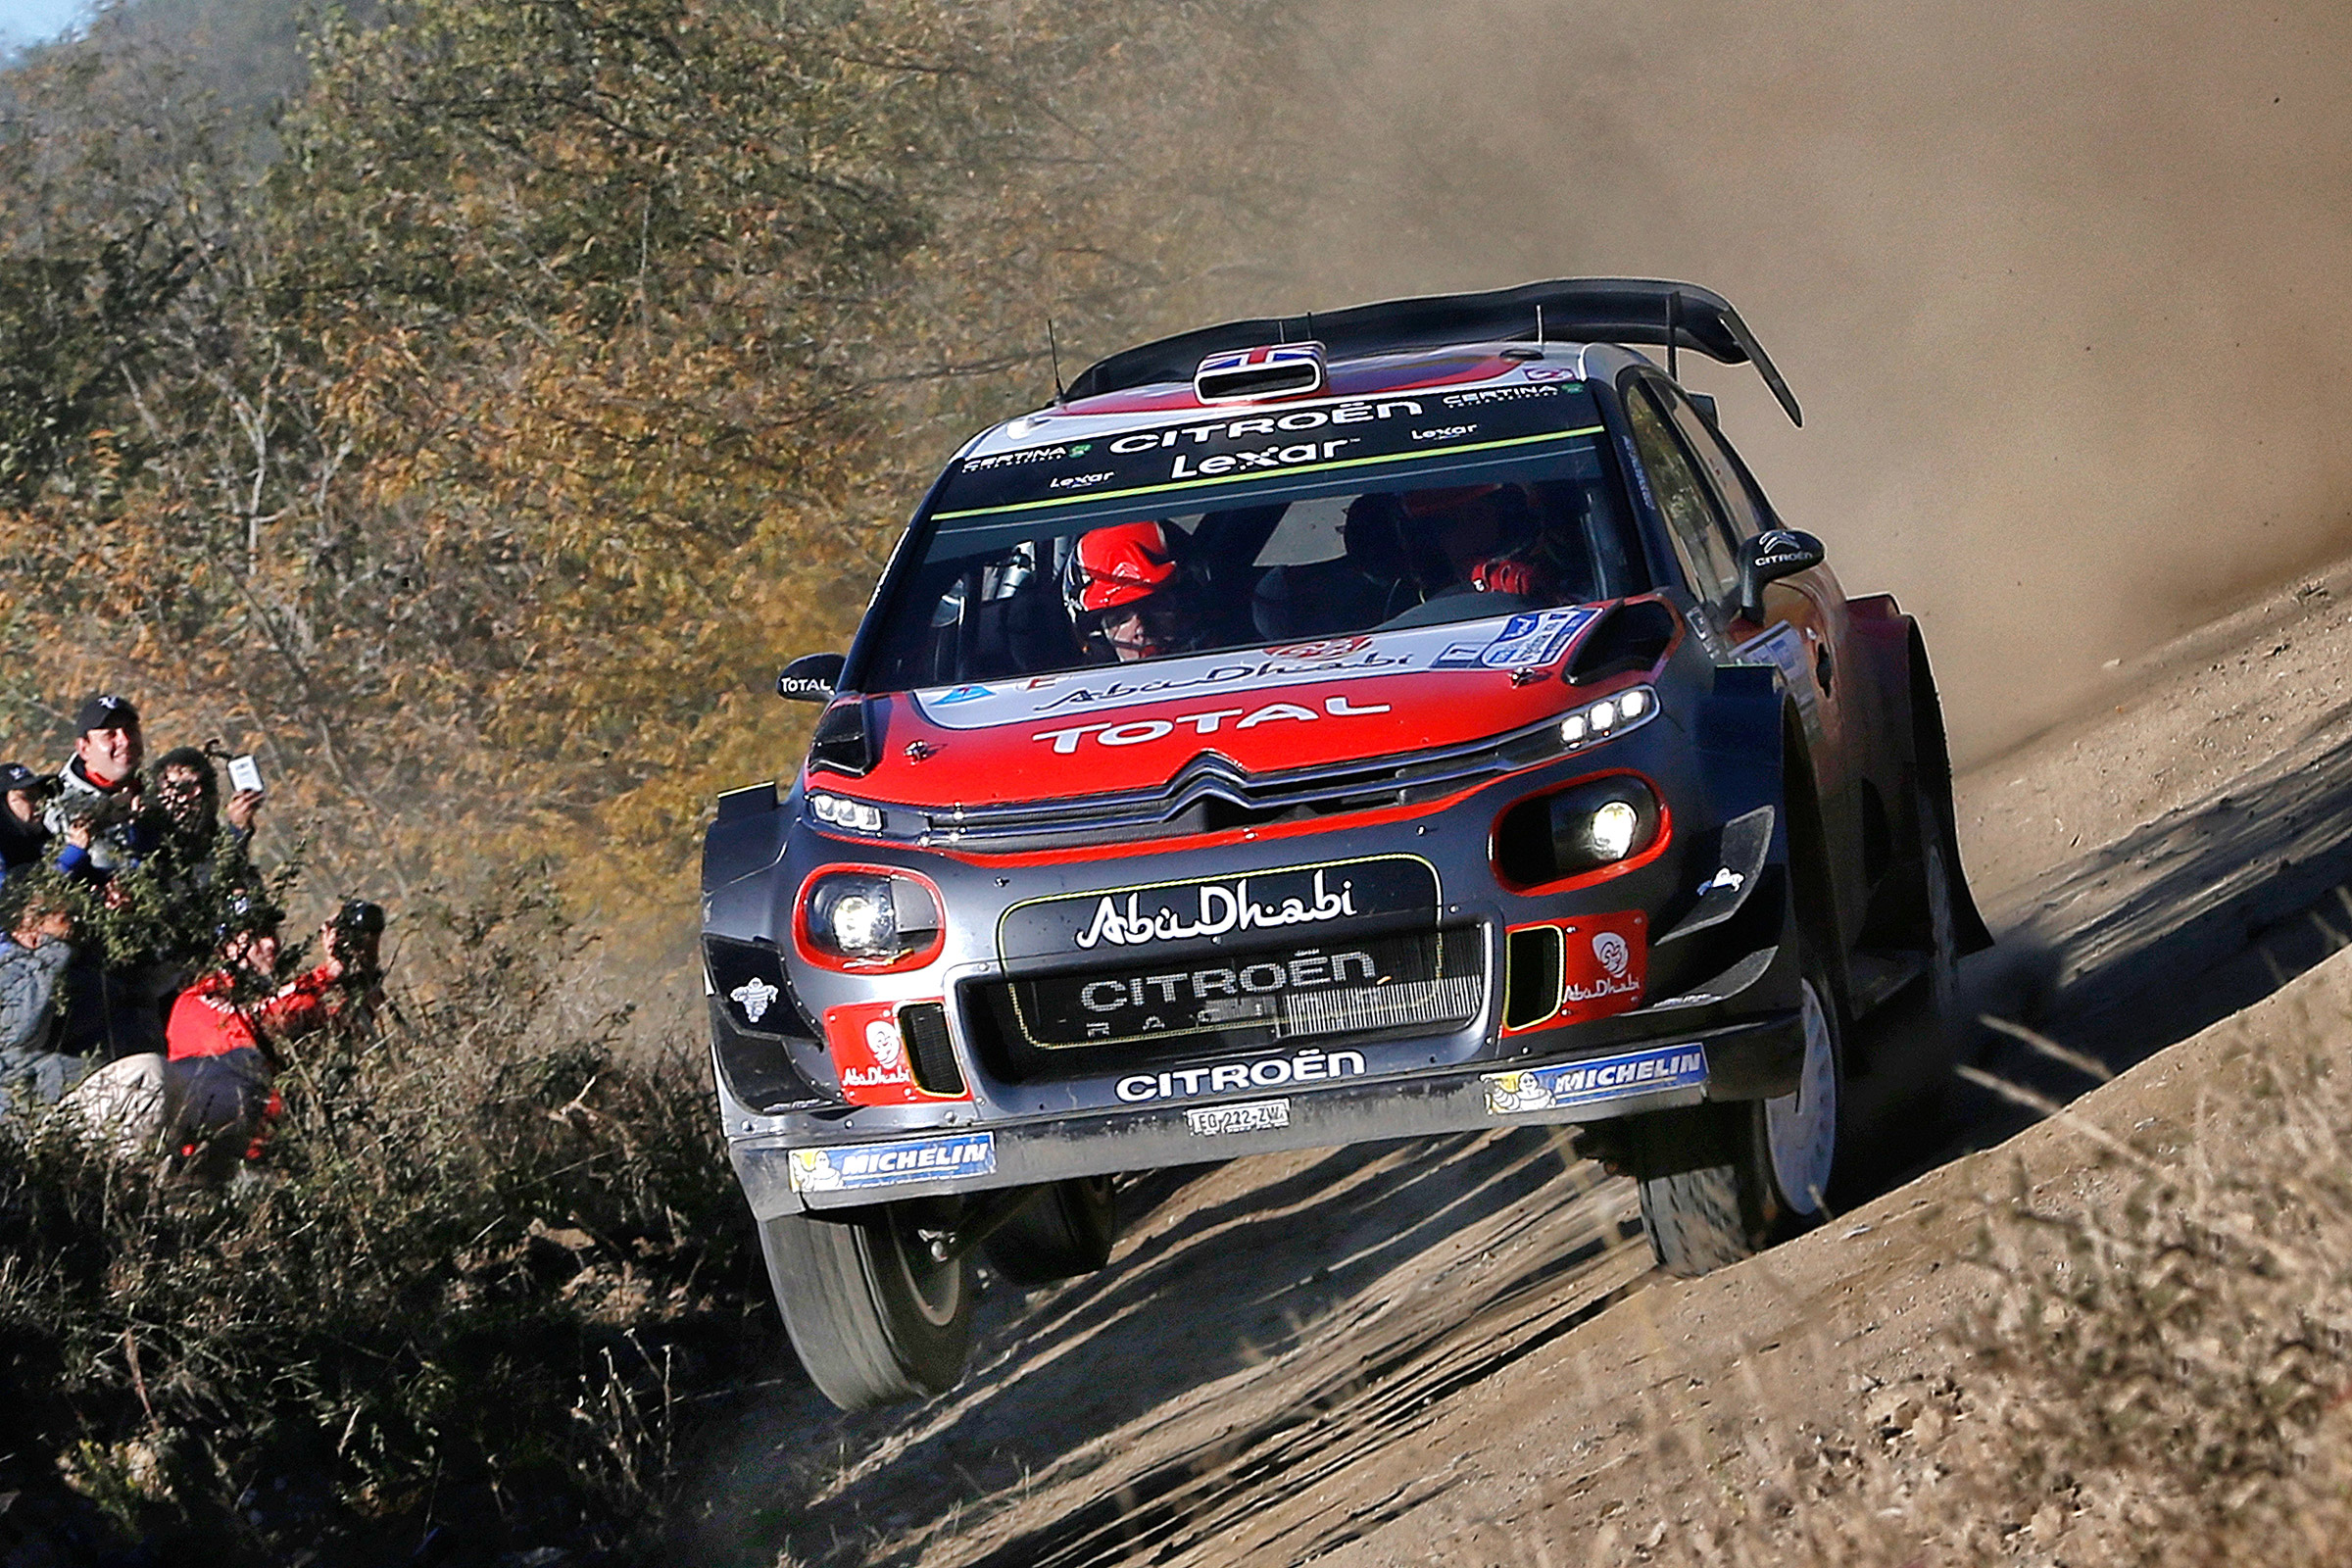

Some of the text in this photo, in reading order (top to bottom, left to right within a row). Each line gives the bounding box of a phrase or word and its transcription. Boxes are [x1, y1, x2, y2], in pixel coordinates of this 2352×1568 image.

[1172, 437, 1348, 478] Lexar
[782, 677, 831, 692] TOTAL
[1032, 697, 1391, 754] TOTAL
[1555, 1053, 1701, 1092] MICHELIN
[842, 1144, 989, 1175] MICHELIN
